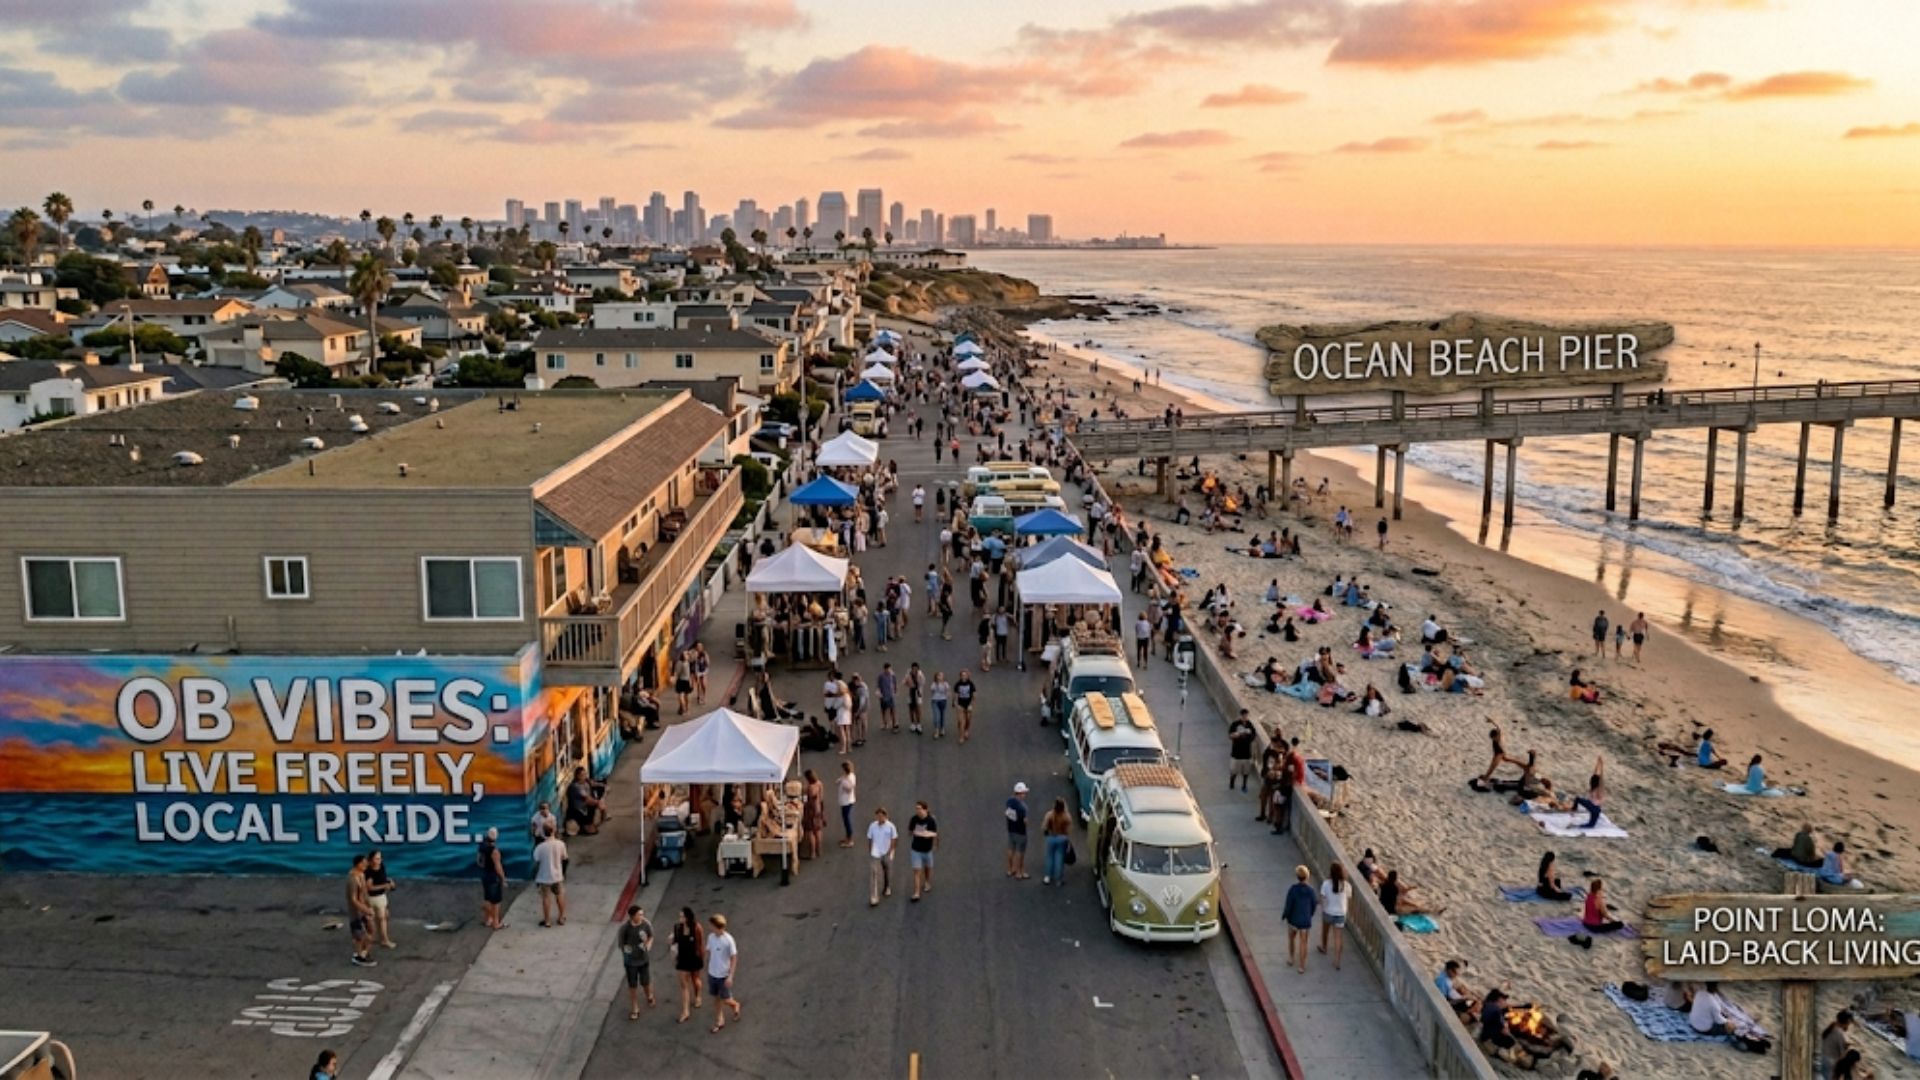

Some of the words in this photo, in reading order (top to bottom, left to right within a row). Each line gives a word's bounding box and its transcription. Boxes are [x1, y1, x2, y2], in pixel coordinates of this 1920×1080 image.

[1293, 341, 1412, 380] OCEAN
[1430, 337, 1544, 376] BEACH
[1559, 334, 1638, 371] PIER
[117, 677, 234, 742] OB
[254, 678, 511, 742] VIBES:
[132, 752, 256, 794] LIVE
[276, 752, 485, 801] FREELY,
[136, 803, 299, 843] LOCAL
[315, 803, 484, 843] PRIDE.
[1694, 907, 1783, 932] POINT
[1791, 907, 1885, 932] LOMA:
[1663, 940, 1820, 965] LAID-BACK
[1828, 940, 1920, 966] LIVING
